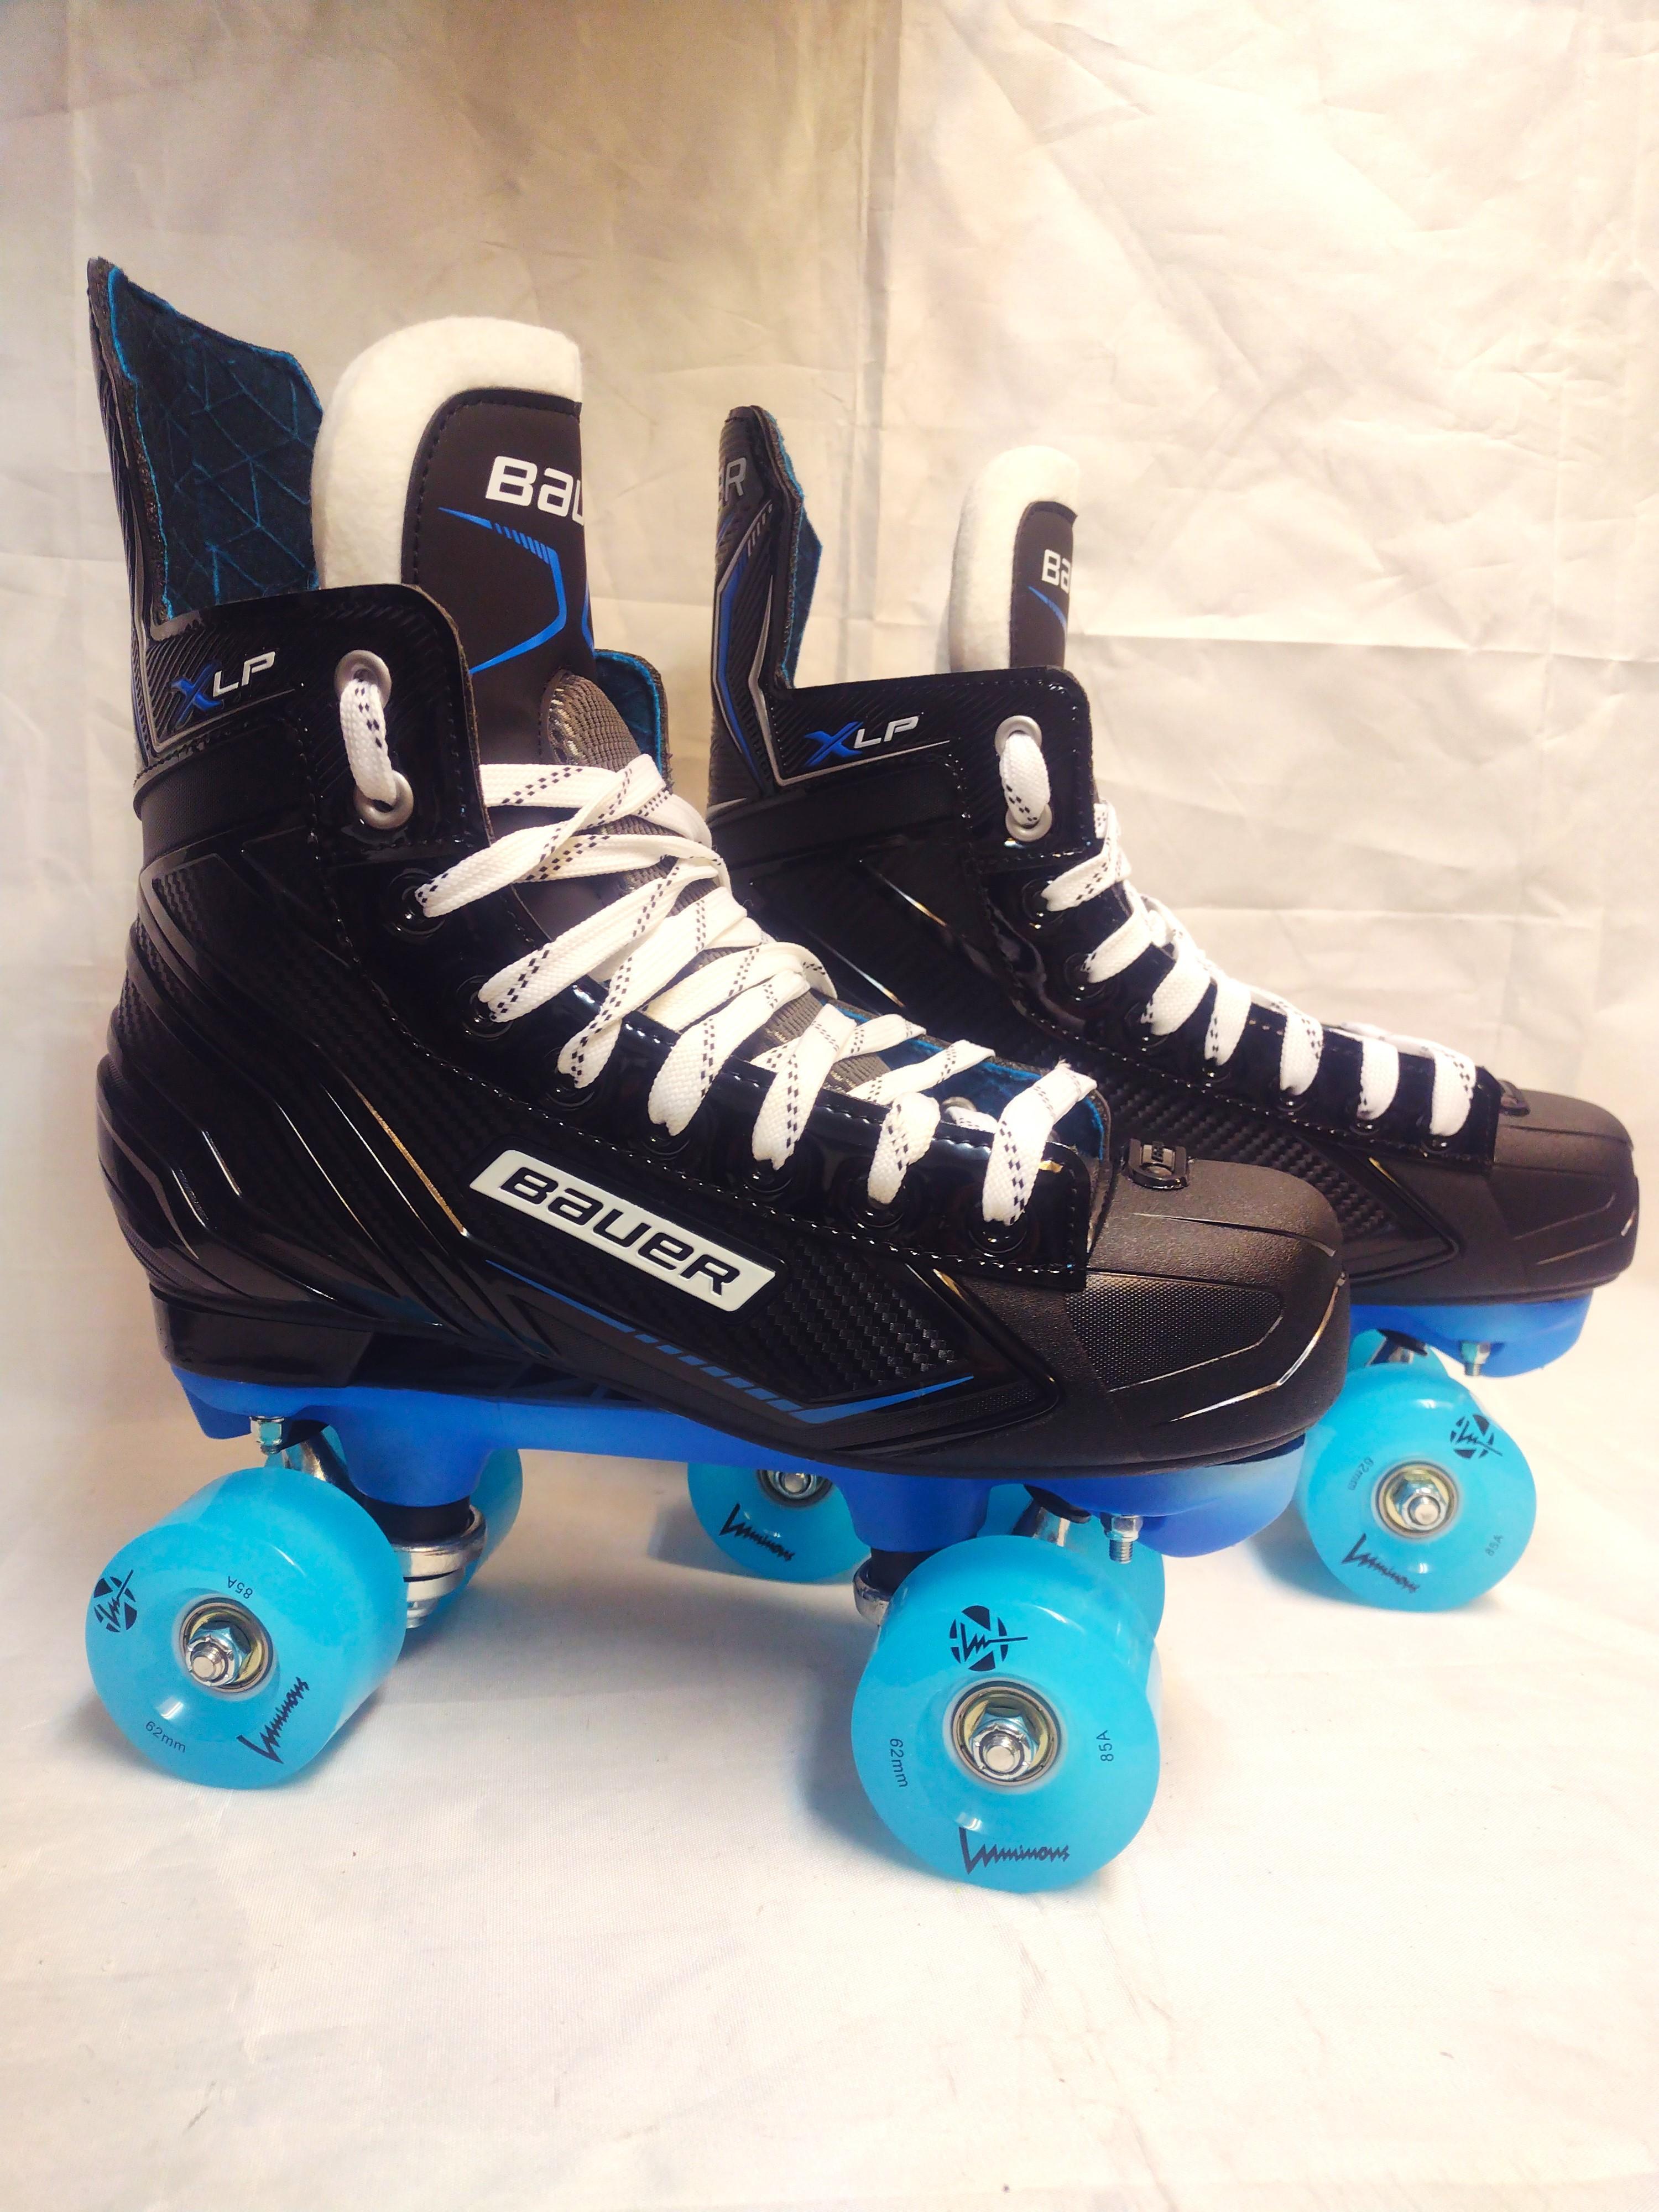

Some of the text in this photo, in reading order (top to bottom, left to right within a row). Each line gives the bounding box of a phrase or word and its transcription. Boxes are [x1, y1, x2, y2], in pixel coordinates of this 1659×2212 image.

[719, 457, 746, 502] R
[170, 651, 275, 729] XLP
[805, 716, 919, 766] XLP
[228, 1575, 253, 1599] 85A
[145, 1721, 186, 1752] 62mm
[236, 1677, 309, 1764] Luminous
[890, 1738, 908, 1788] 62mm
[1097, 1730, 1114, 1761] 85A
[959, 1827, 1070, 1874] Luminous
